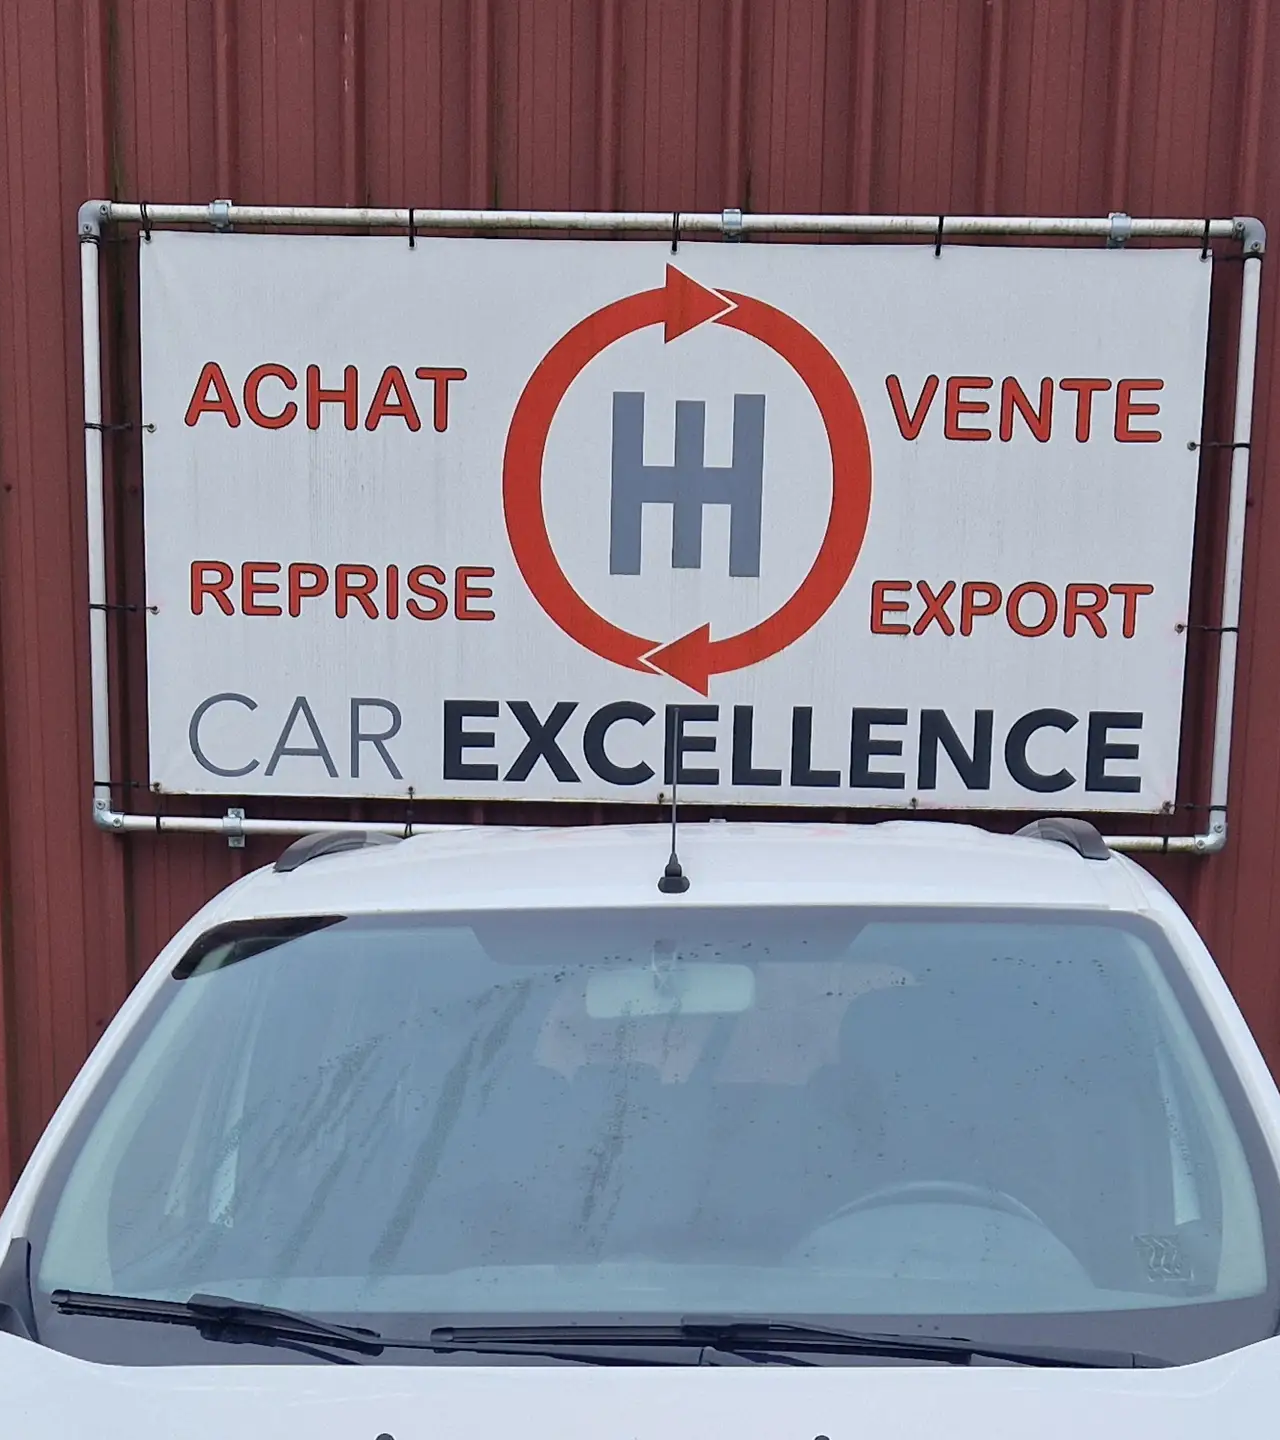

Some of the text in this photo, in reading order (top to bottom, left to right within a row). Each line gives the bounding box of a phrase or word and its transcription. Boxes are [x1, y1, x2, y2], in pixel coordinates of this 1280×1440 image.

[184, 361, 468, 432] ACHAT
[885, 374, 1165, 443] VENTE
[190, 560, 496, 621] REPRISE
[870, 580, 1155, 639] EXPORT
[188, 692, 1144, 793] CAR EXCELLENCE
